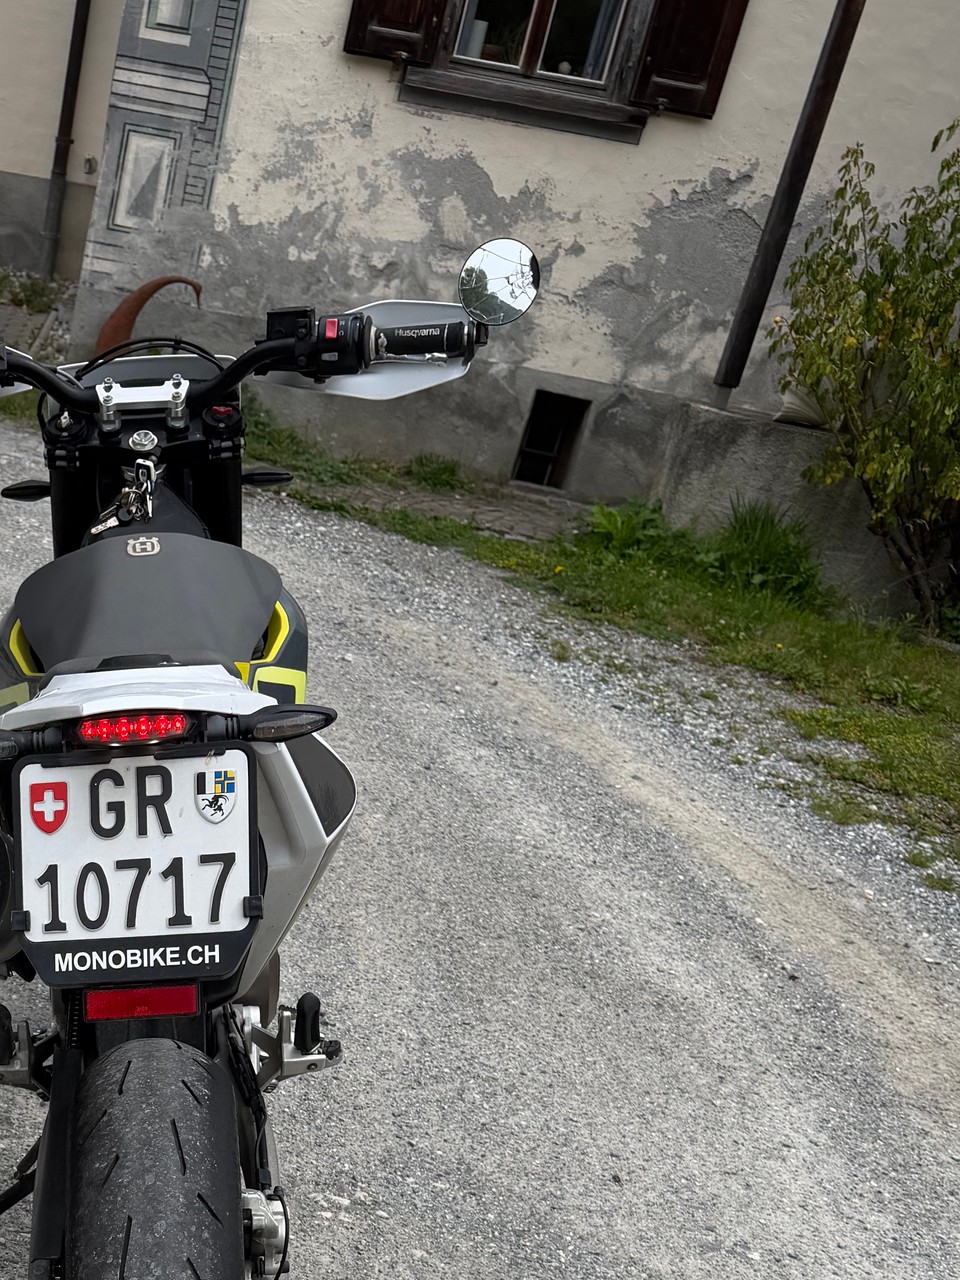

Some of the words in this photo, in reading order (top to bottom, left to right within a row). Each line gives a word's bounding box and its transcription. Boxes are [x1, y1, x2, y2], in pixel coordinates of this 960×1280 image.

[394, 327, 440, 338] Husqvarna
[90, 765, 173, 839] GR
[35, 852, 236, 933] 10717
[54, 945, 220, 972] MONOBIKE.CH
